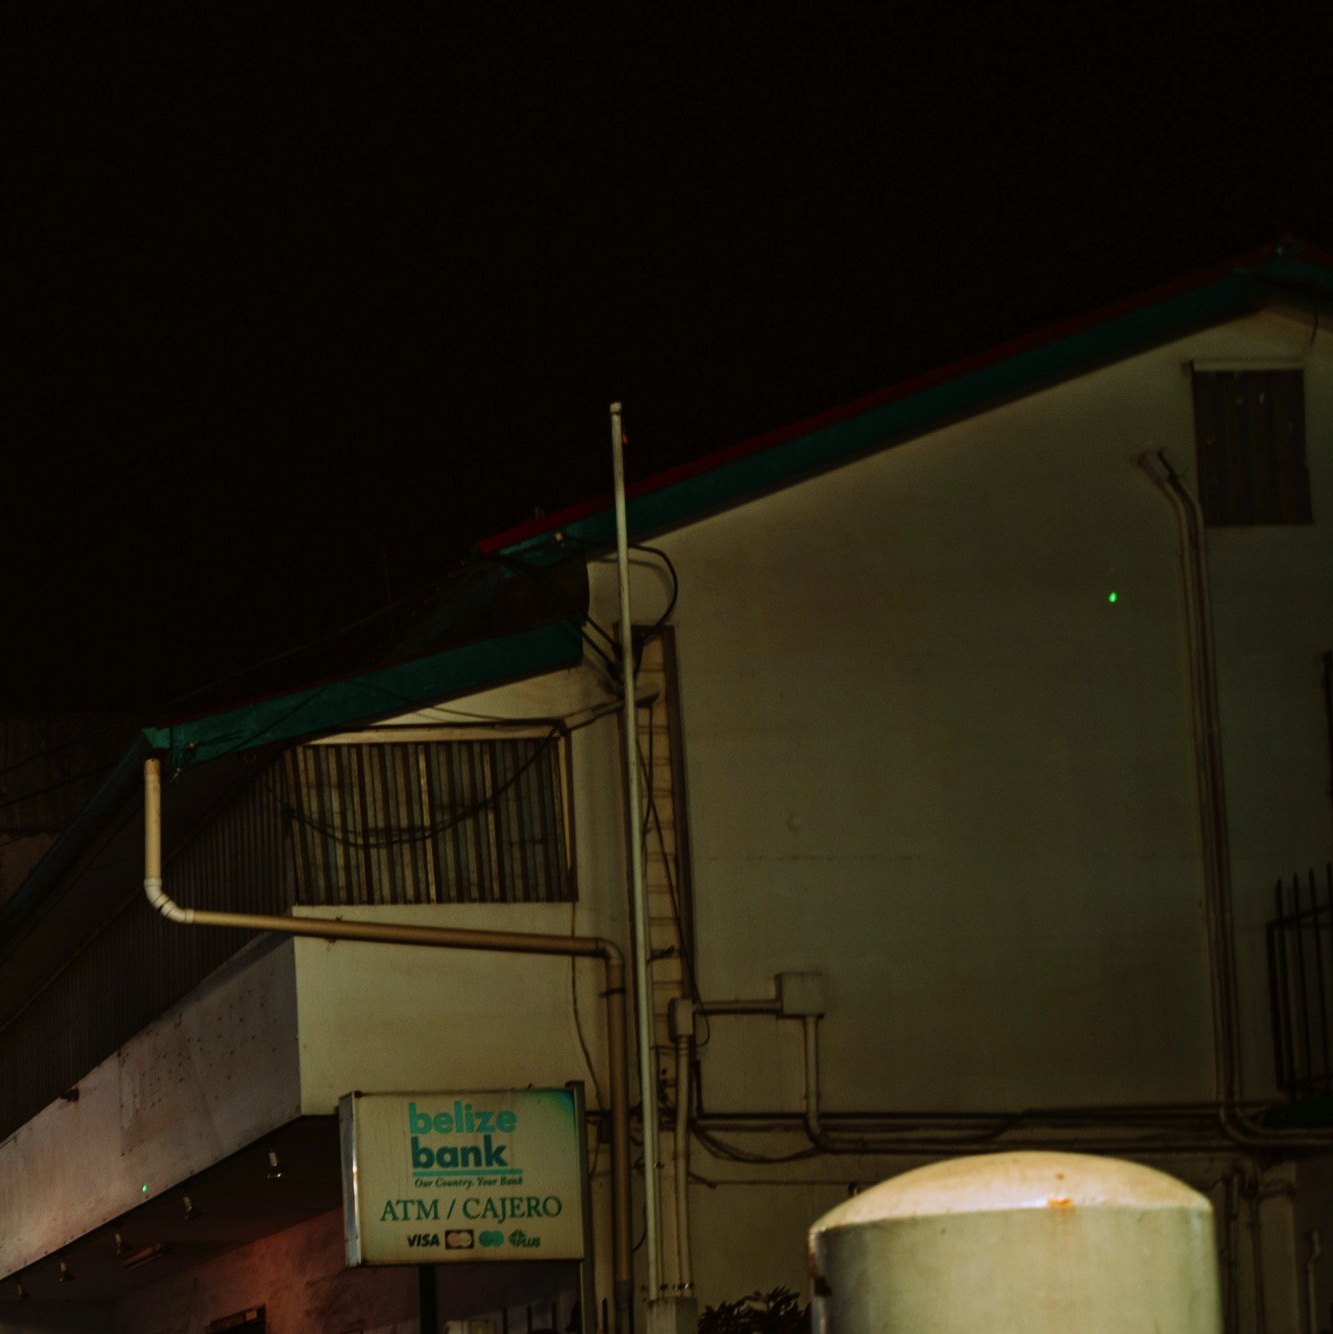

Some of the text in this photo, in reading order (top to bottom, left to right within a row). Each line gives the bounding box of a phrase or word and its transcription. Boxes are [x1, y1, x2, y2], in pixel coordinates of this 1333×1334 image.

[408, 1100, 517, 1134] belize
[411, 1135, 508, 1168] bank
[414, 1178, 433, 1188] Our
[477, 1176, 498, 1187] Your
[500, 1176, 523, 1186] Bank
[380, 1195, 563, 1225] ATM / CAJERO
[407, 1233, 440, 1248] VISA
